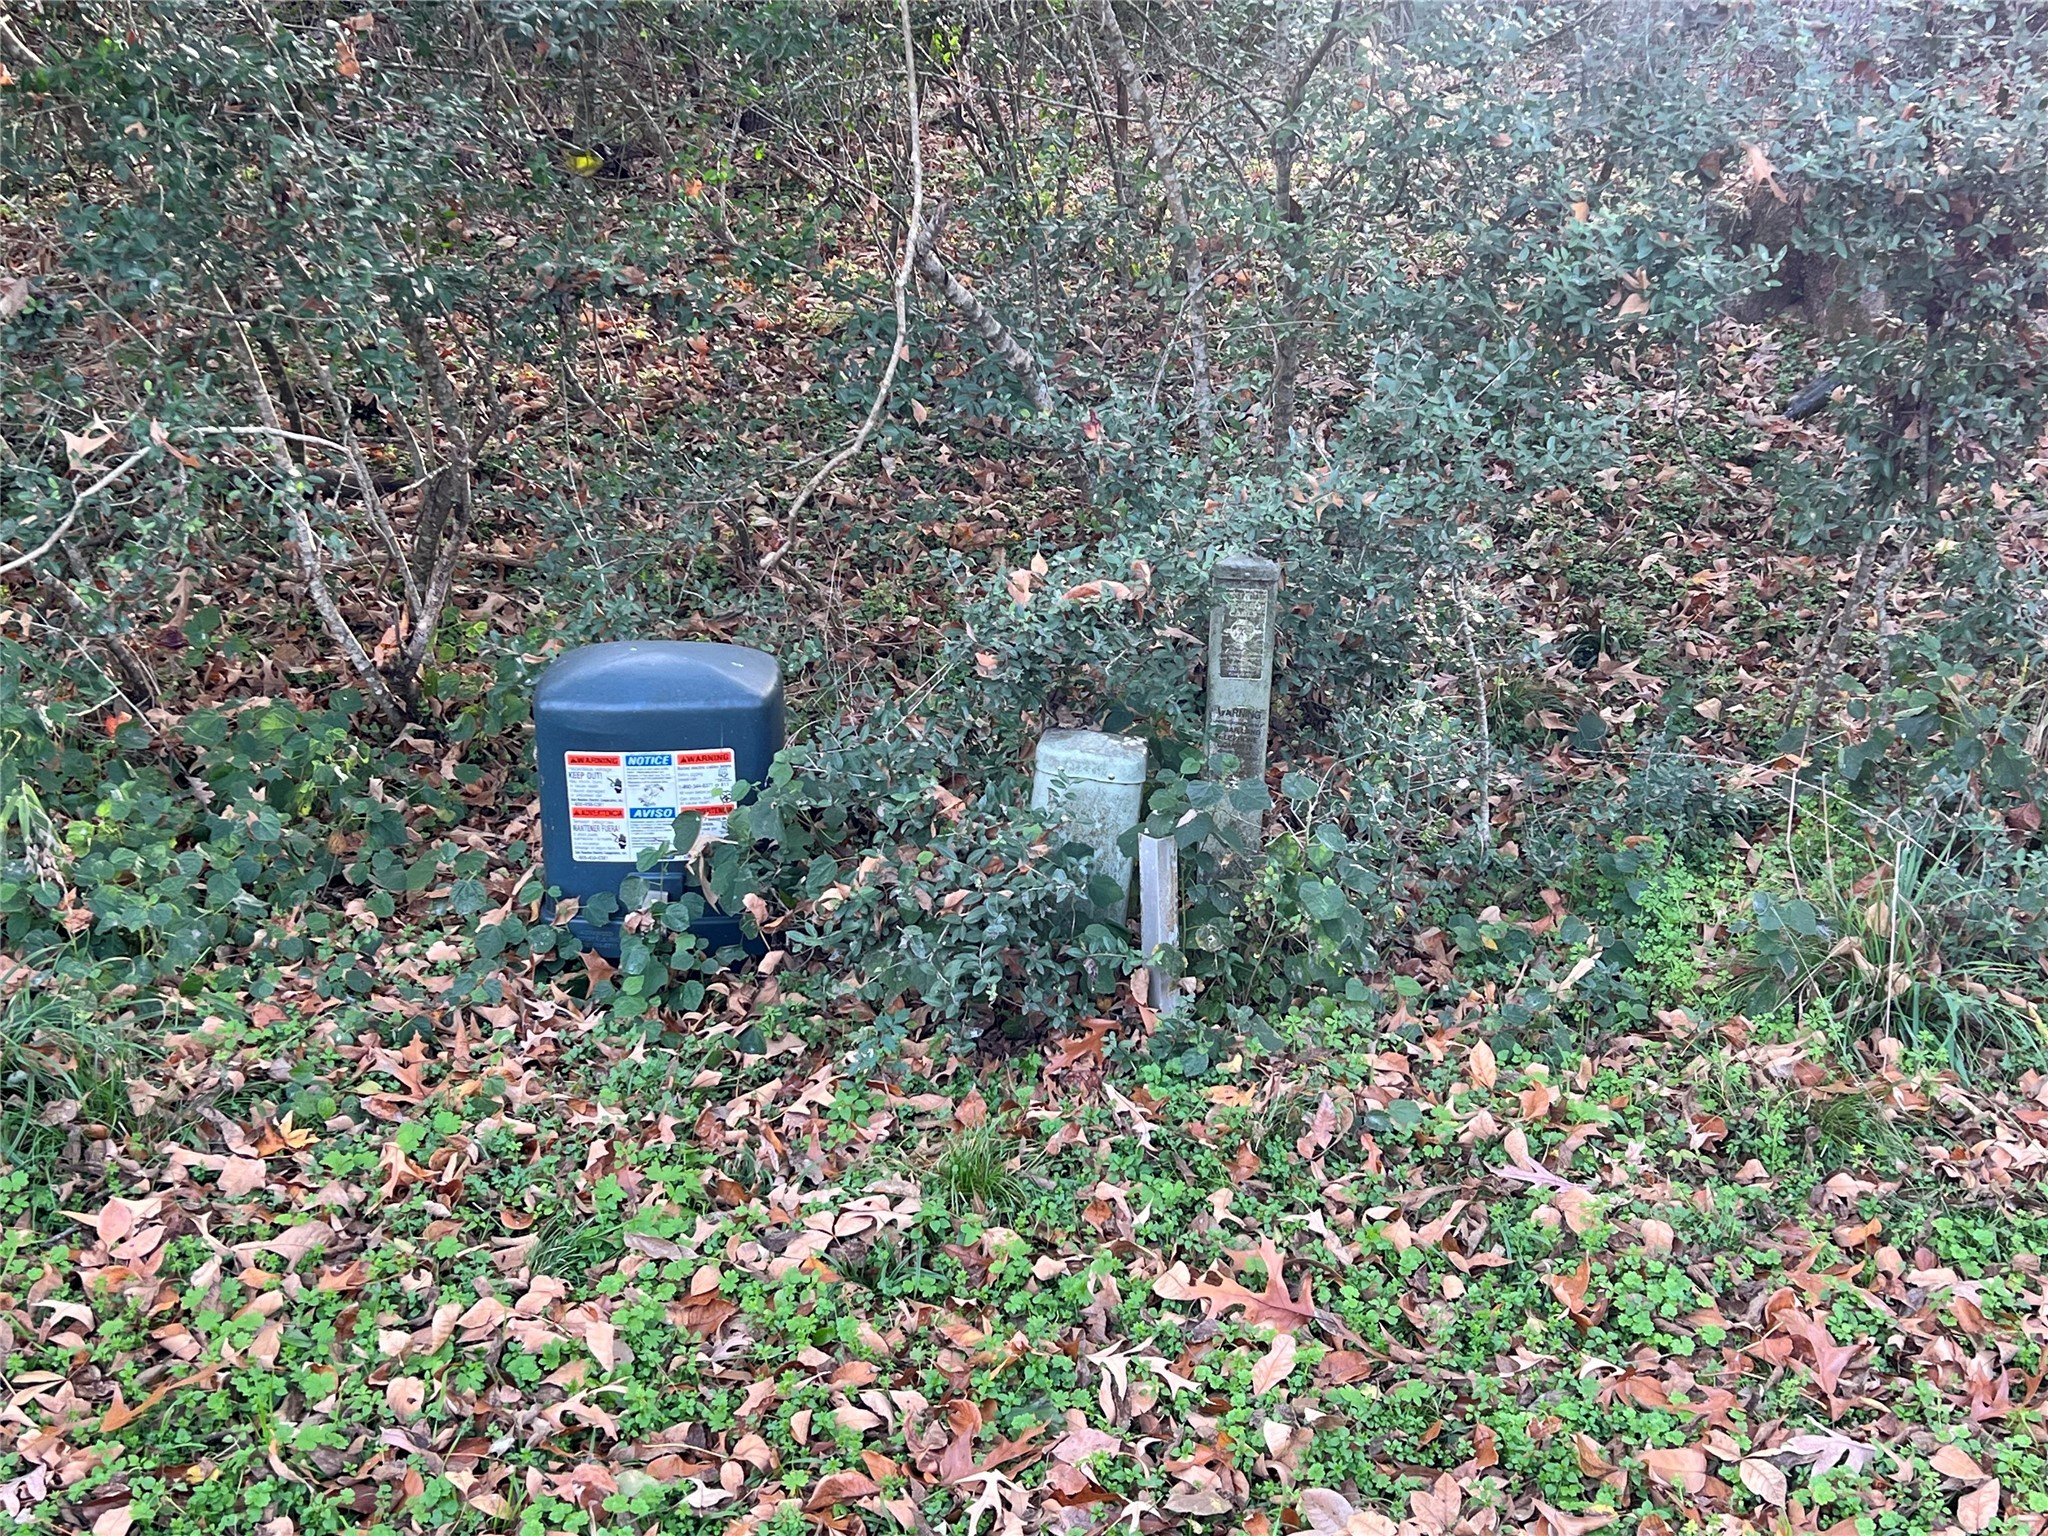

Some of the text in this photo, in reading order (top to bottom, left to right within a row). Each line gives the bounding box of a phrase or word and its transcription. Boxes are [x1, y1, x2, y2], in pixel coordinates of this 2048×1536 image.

[627, 755, 670, 766] NOTICE
[687, 753, 729, 763] WARNING
[633, 808, 673, 818] AVISO
